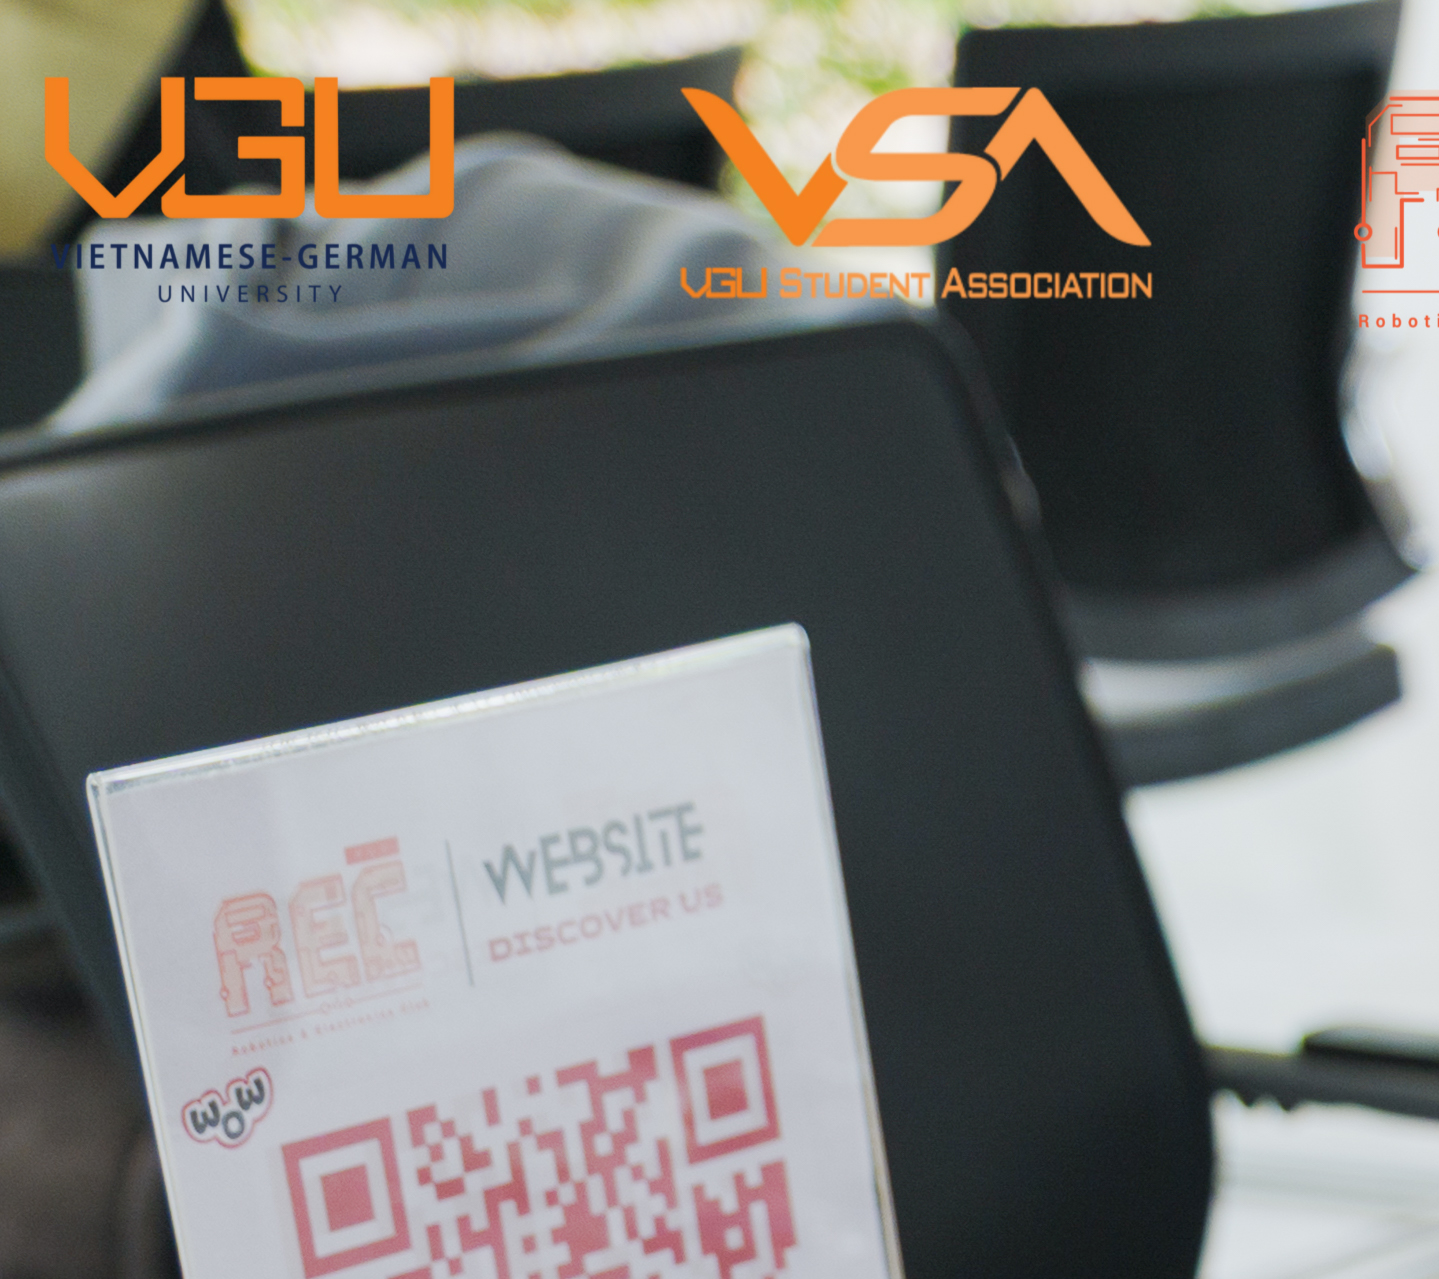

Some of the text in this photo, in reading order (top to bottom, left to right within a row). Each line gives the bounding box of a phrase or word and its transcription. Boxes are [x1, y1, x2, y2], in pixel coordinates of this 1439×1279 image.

[483, 801, 706, 905] WEBSITE
[487, 881, 726, 963] DISCOVER US
